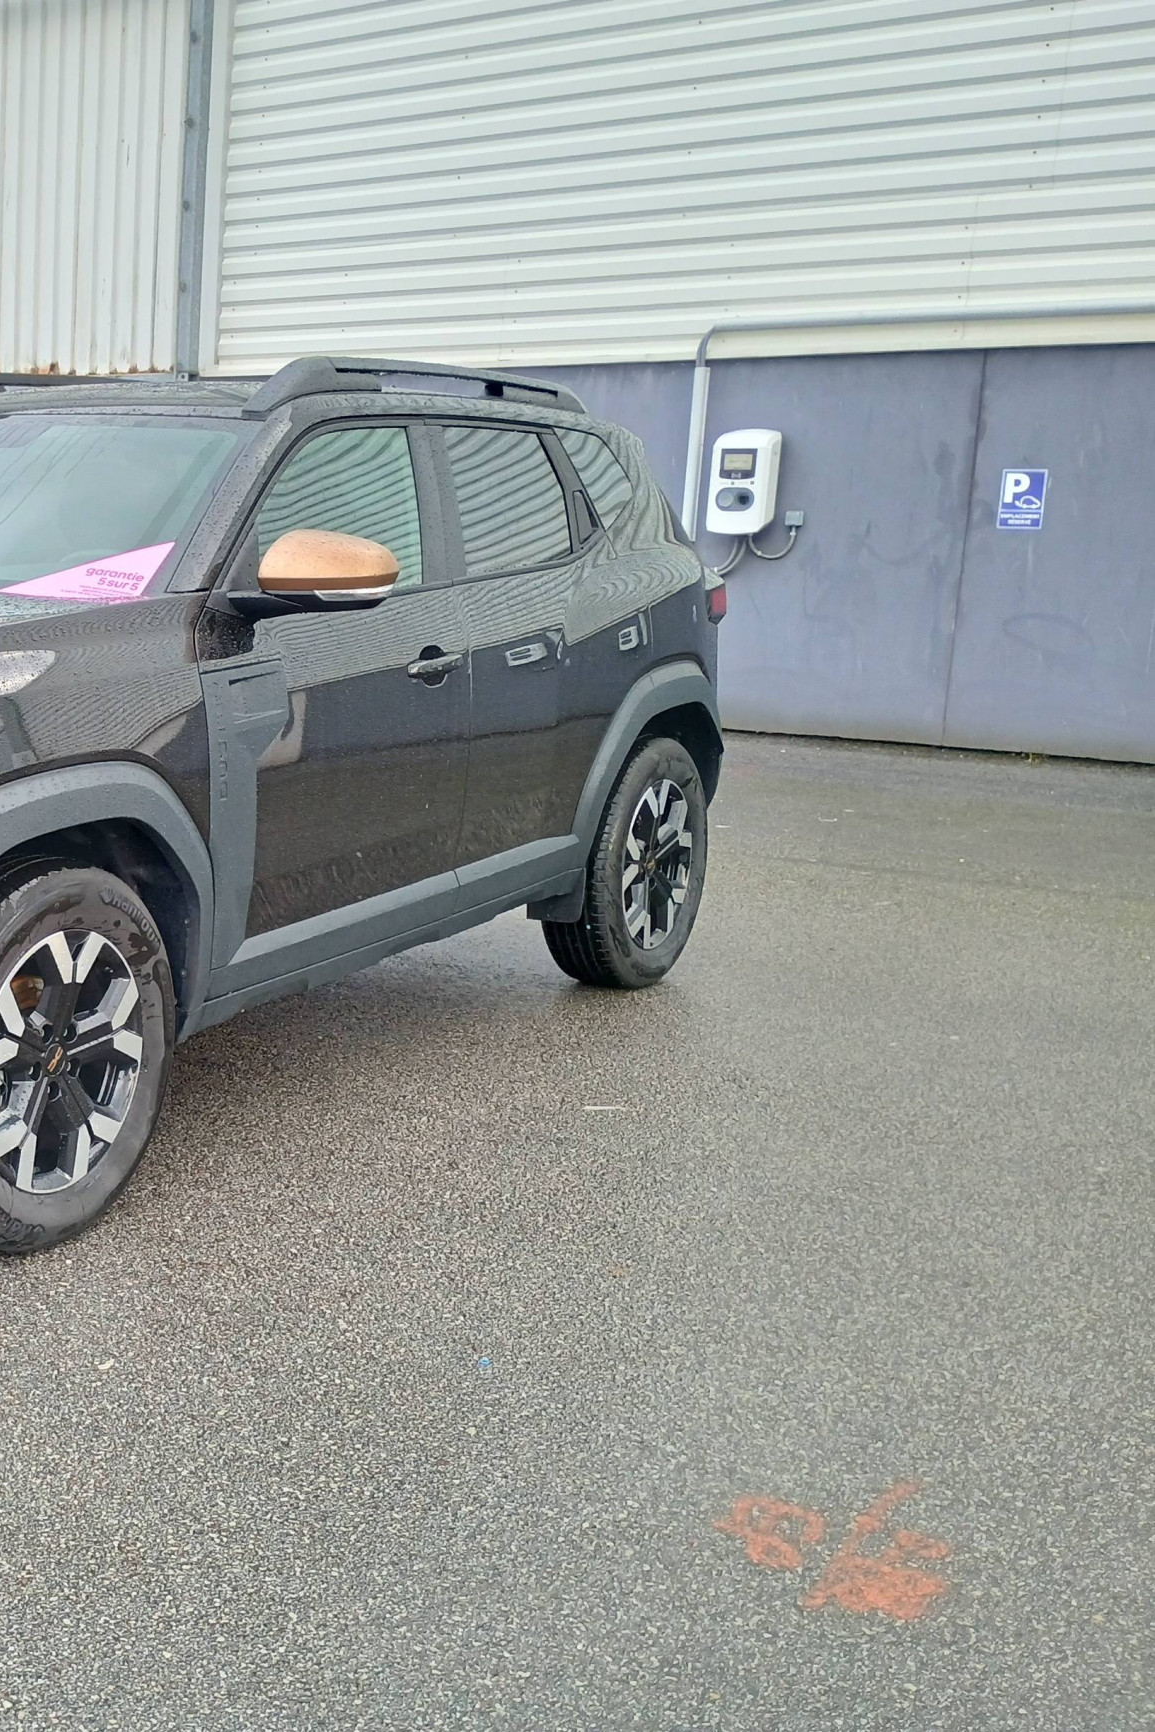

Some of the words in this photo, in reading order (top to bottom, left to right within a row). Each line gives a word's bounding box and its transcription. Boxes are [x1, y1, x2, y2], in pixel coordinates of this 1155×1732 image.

[1003, 473, 1031, 503] P
[86, 567, 145, 582] garantie
[97, 577, 108, 586] 5
[106, 580, 130, 589] sur
[129, 582, 140, 591] 5
